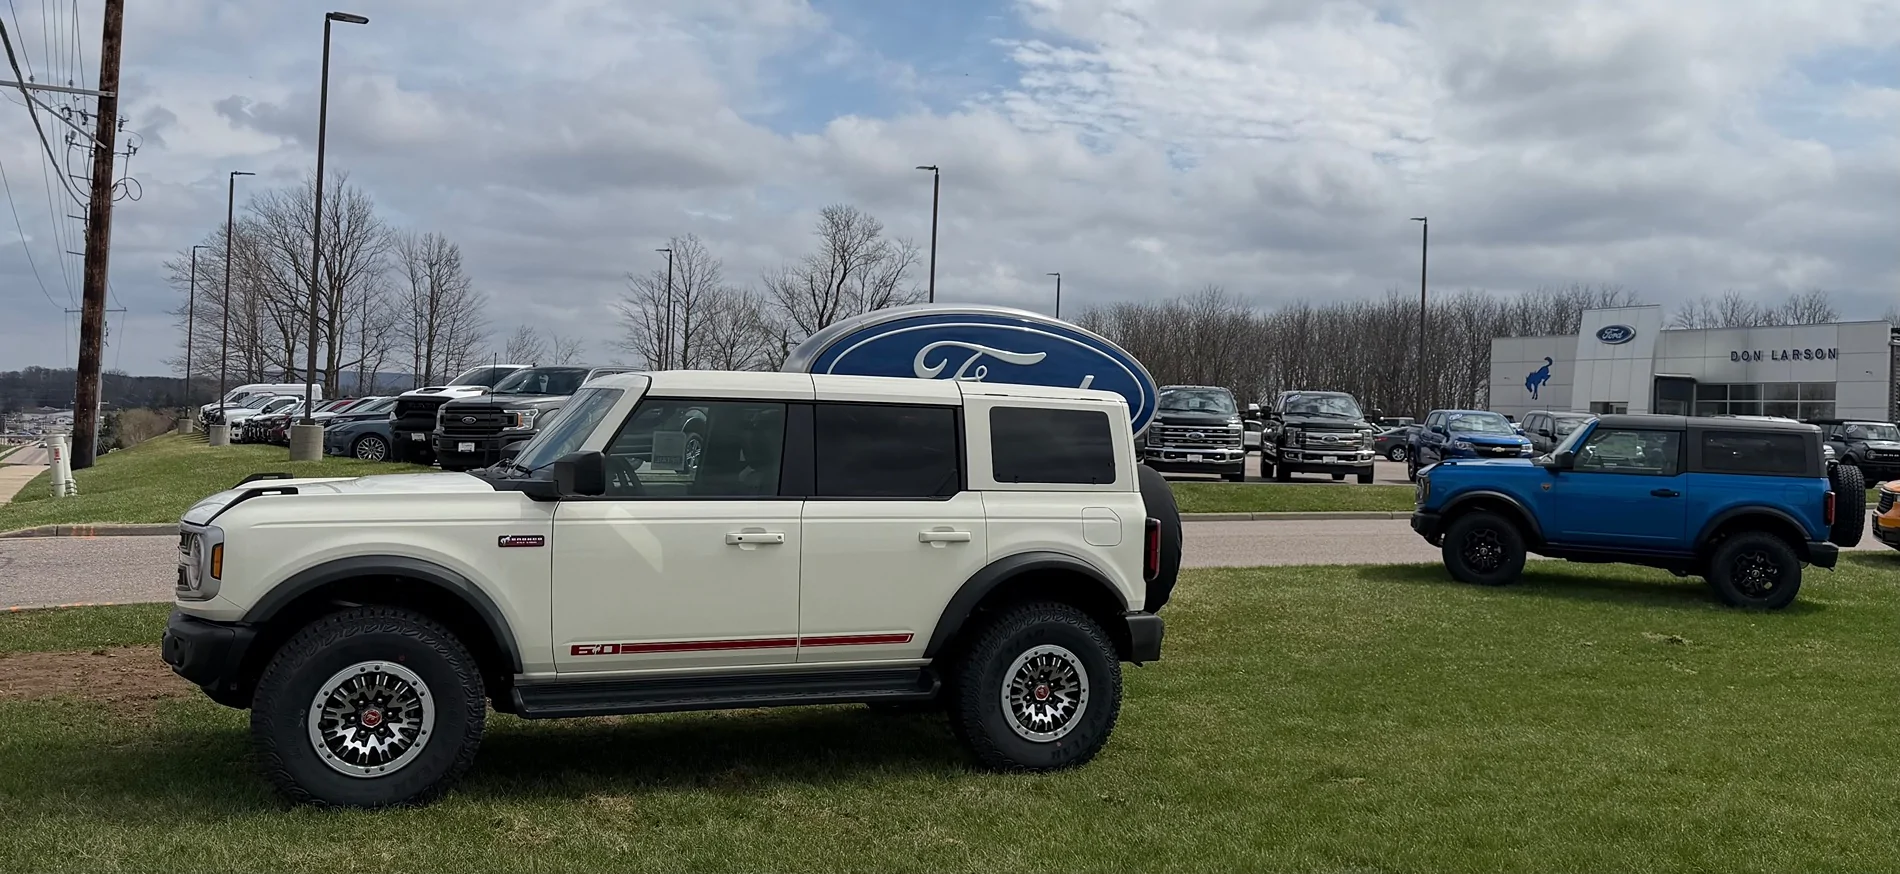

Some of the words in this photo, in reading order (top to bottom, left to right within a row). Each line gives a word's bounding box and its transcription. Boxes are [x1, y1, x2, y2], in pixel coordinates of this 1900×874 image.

[1602, 328, 1624, 339] Ford
[1730, 350, 1761, 361] DON
[1771, 348, 1837, 360] LARSON
